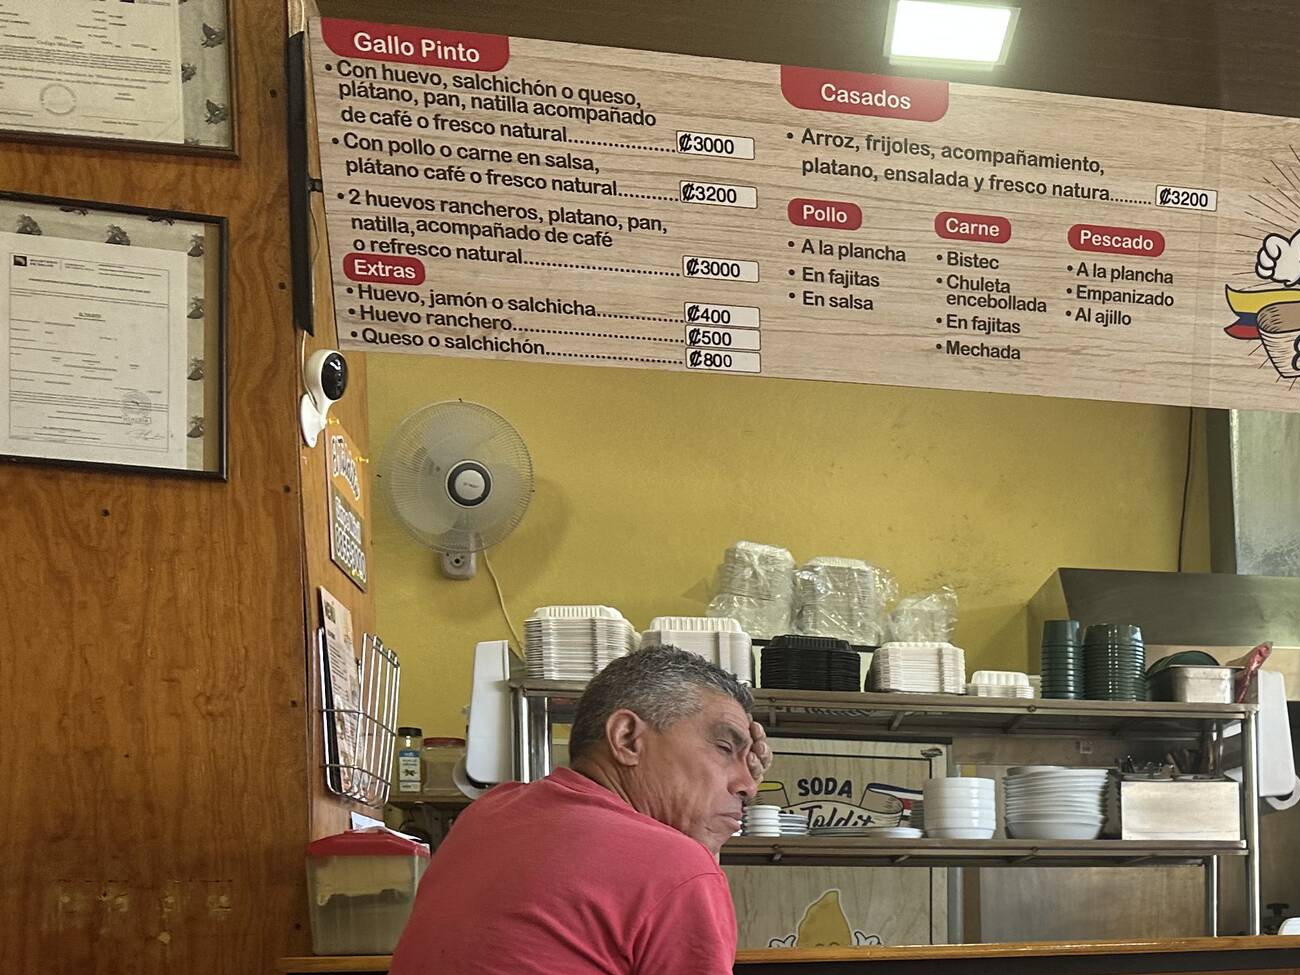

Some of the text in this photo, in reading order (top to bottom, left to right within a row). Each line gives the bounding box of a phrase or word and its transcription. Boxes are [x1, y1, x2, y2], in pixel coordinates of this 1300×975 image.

[353, 32, 480, 63] Gallo Pinto
[337, 60, 641, 108] Con huevo, salchichón o queso,
[339, 81, 656, 126] plátano, pan, natilla acompañado
[820, 83, 911, 110] Casados
[341, 106, 366, 123] de
[370, 110, 412, 126] café
[417, 116, 428, 128] o
[433, 114, 495, 135] fresco
[802, 128, 1104, 176] Arroz, frijoles, acompañamiento,
[346, 157, 418, 177] plátano
[424, 166, 465, 182] café
[470, 171, 481, 183] o
[485, 170, 547, 189] fresco
[802, 159, 878, 182] platano,
[884, 169, 969, 188] ensalada
[974, 176, 984, 192] y
[989, 174, 1047, 196] fresco
[349, 189, 667, 234] 2 huevos rancheros, platano, pan,
[802, 205, 848, 223] Pollo
[352, 217, 613, 247] natilla, acompañado de café
[945, 219, 1000, 237] Carne
[353, 239, 365, 251] o
[370, 239, 451, 258] refresco
[802, 239, 906, 263] A la plancha
[1079, 230, 1154, 251] Pescado
[354, 260, 416, 279] Extras
[947, 251, 999, 269] Bistec
[802, 267, 880, 289] En fajitas
[946, 275, 1010, 293] Chuleta
[359, 284, 424, 306] Huevo,
[428, 290, 487, 308] jamón
[492, 297, 503, 309] o
[802, 290, 873, 311] En salsa
[946, 293, 1047, 313] encebollada
[1076, 284, 1174, 308] Empanizado
[360, 305, 420, 323] Huevo
[1075, 309, 1131, 327] Al ajillo
[362, 328, 423, 346] Queso
[429, 335, 440, 348] o
[946, 341, 1020, 360] Mechada
[797, 777, 852, 798] SODA
[800, 805, 876, 828] Toldit
